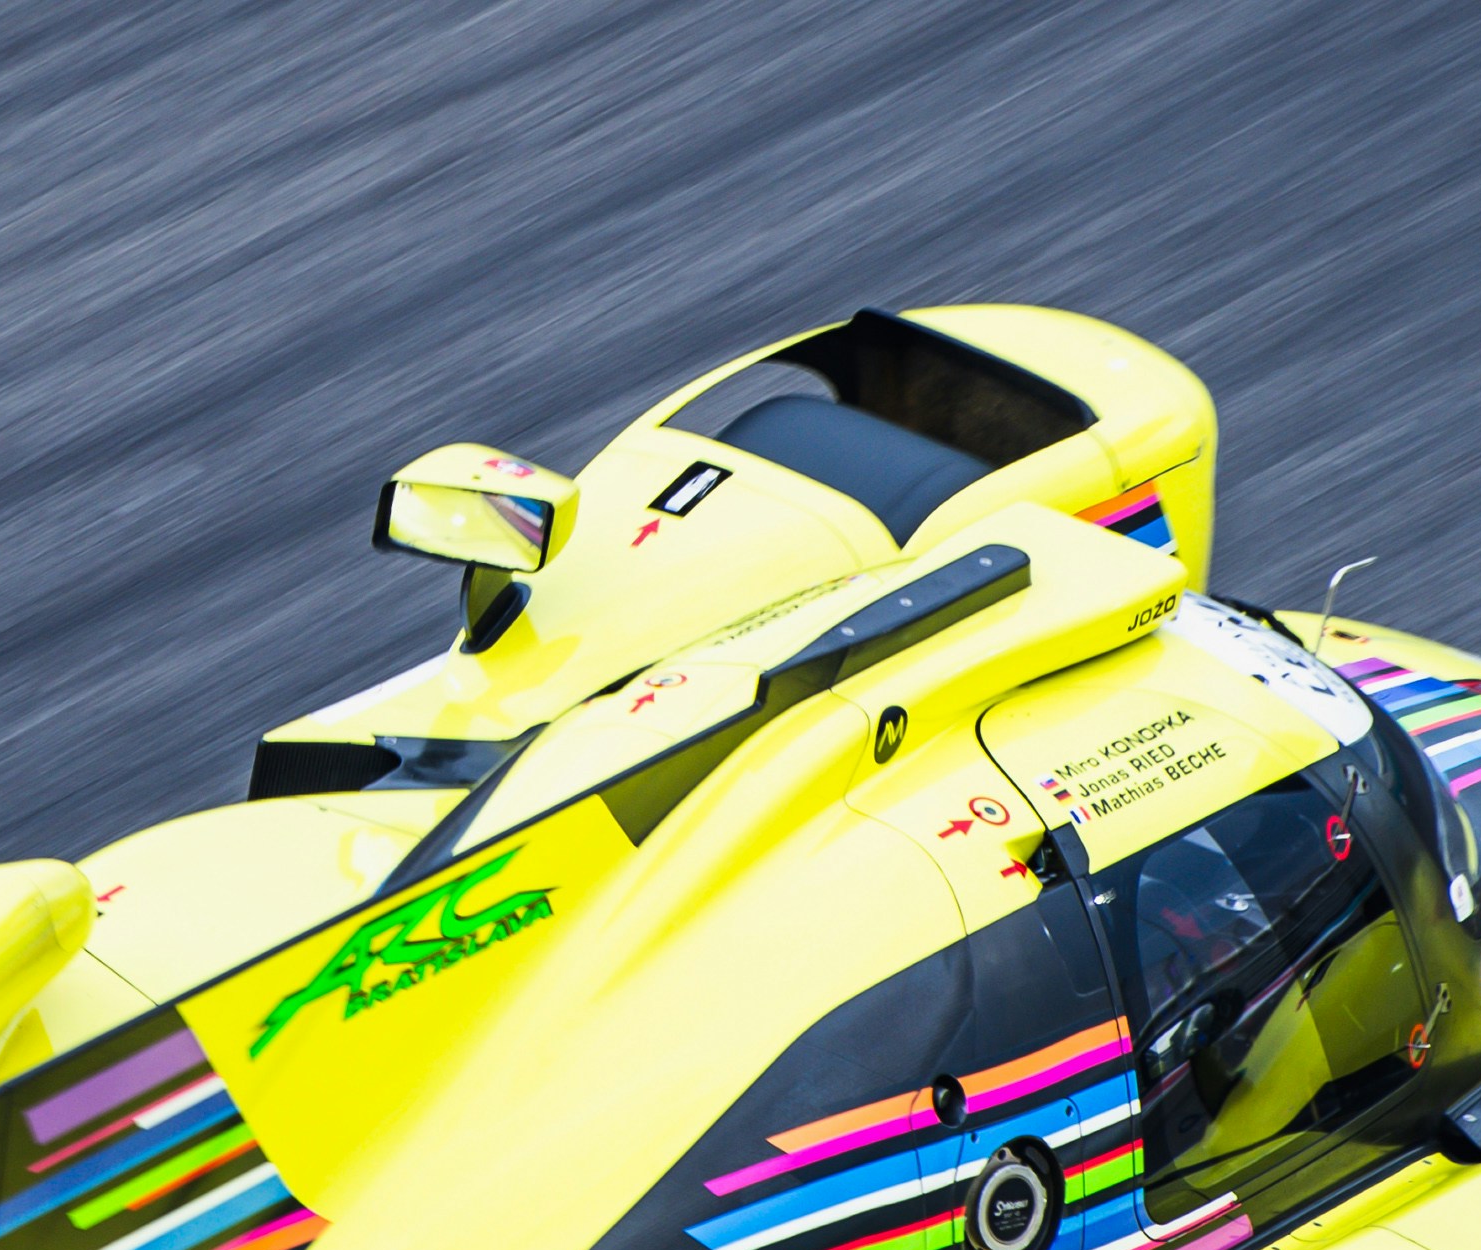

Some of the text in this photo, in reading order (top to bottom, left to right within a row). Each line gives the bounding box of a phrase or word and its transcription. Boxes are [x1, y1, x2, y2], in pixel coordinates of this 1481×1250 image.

[1054, 710, 1195, 781] Miro KONOPKA
[1080, 742, 1176, 799] Jonas RIED
[1091, 742, 1227, 818] Mathias BECHE
